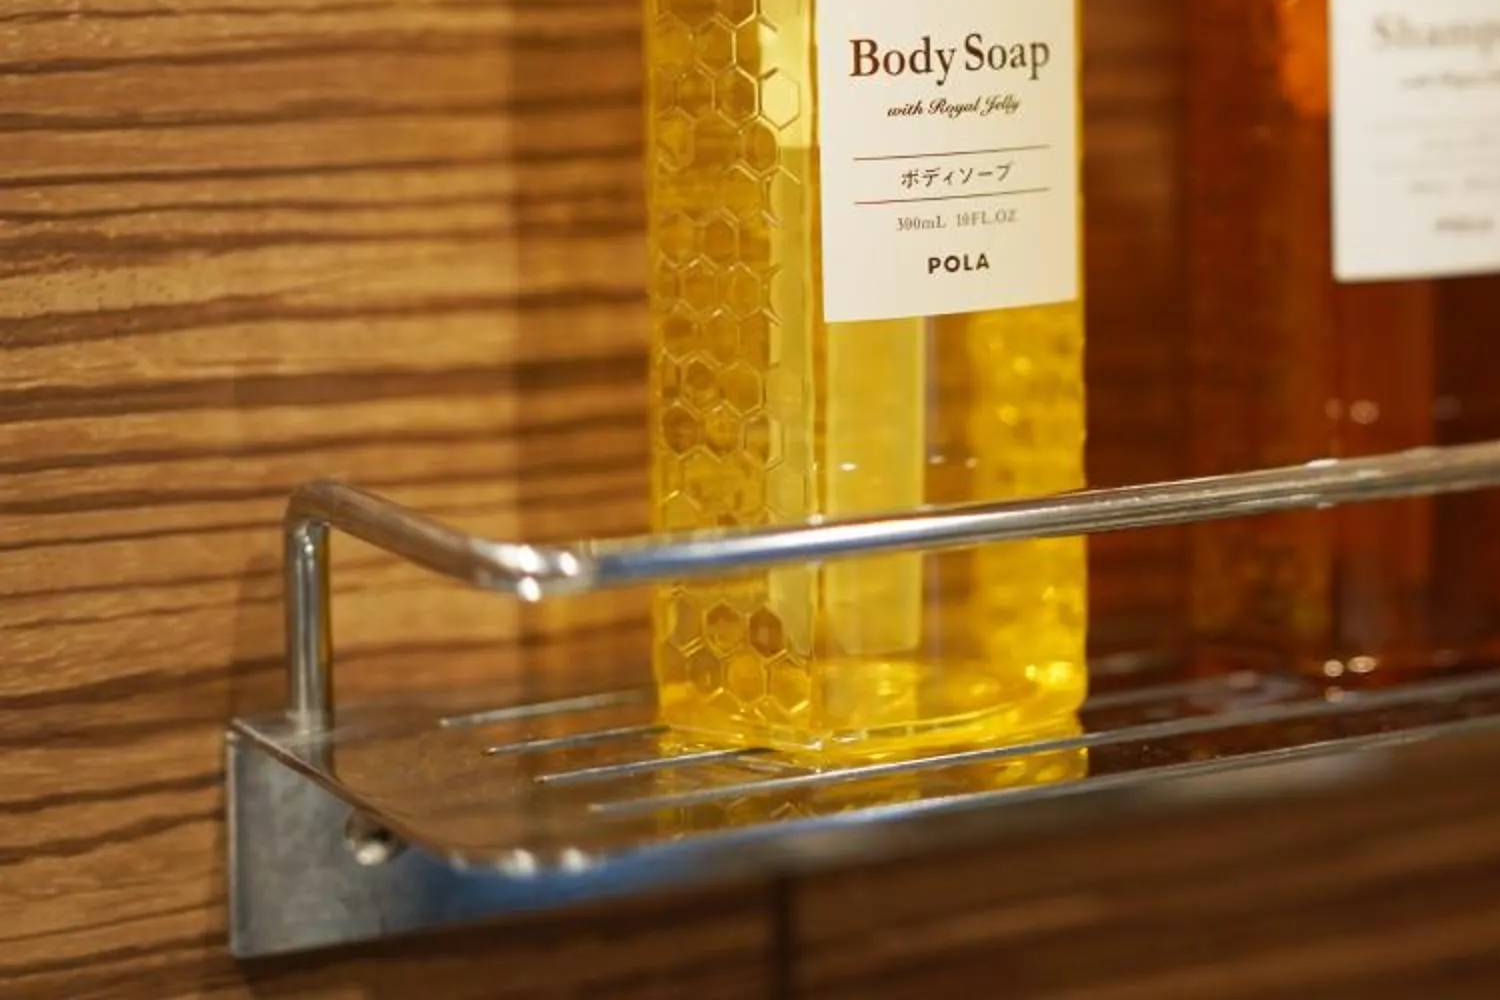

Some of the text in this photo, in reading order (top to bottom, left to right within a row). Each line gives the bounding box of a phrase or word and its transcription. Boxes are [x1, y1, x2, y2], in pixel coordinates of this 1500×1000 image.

[849, 33, 1050, 86] Body Soap
[887, 94, 1020, 119] with Royal Jelly
[900, 160, 1015, 189] ボディソープ
[897, 214, 947, 232] 300mL
[927, 253, 991, 275] POLA
